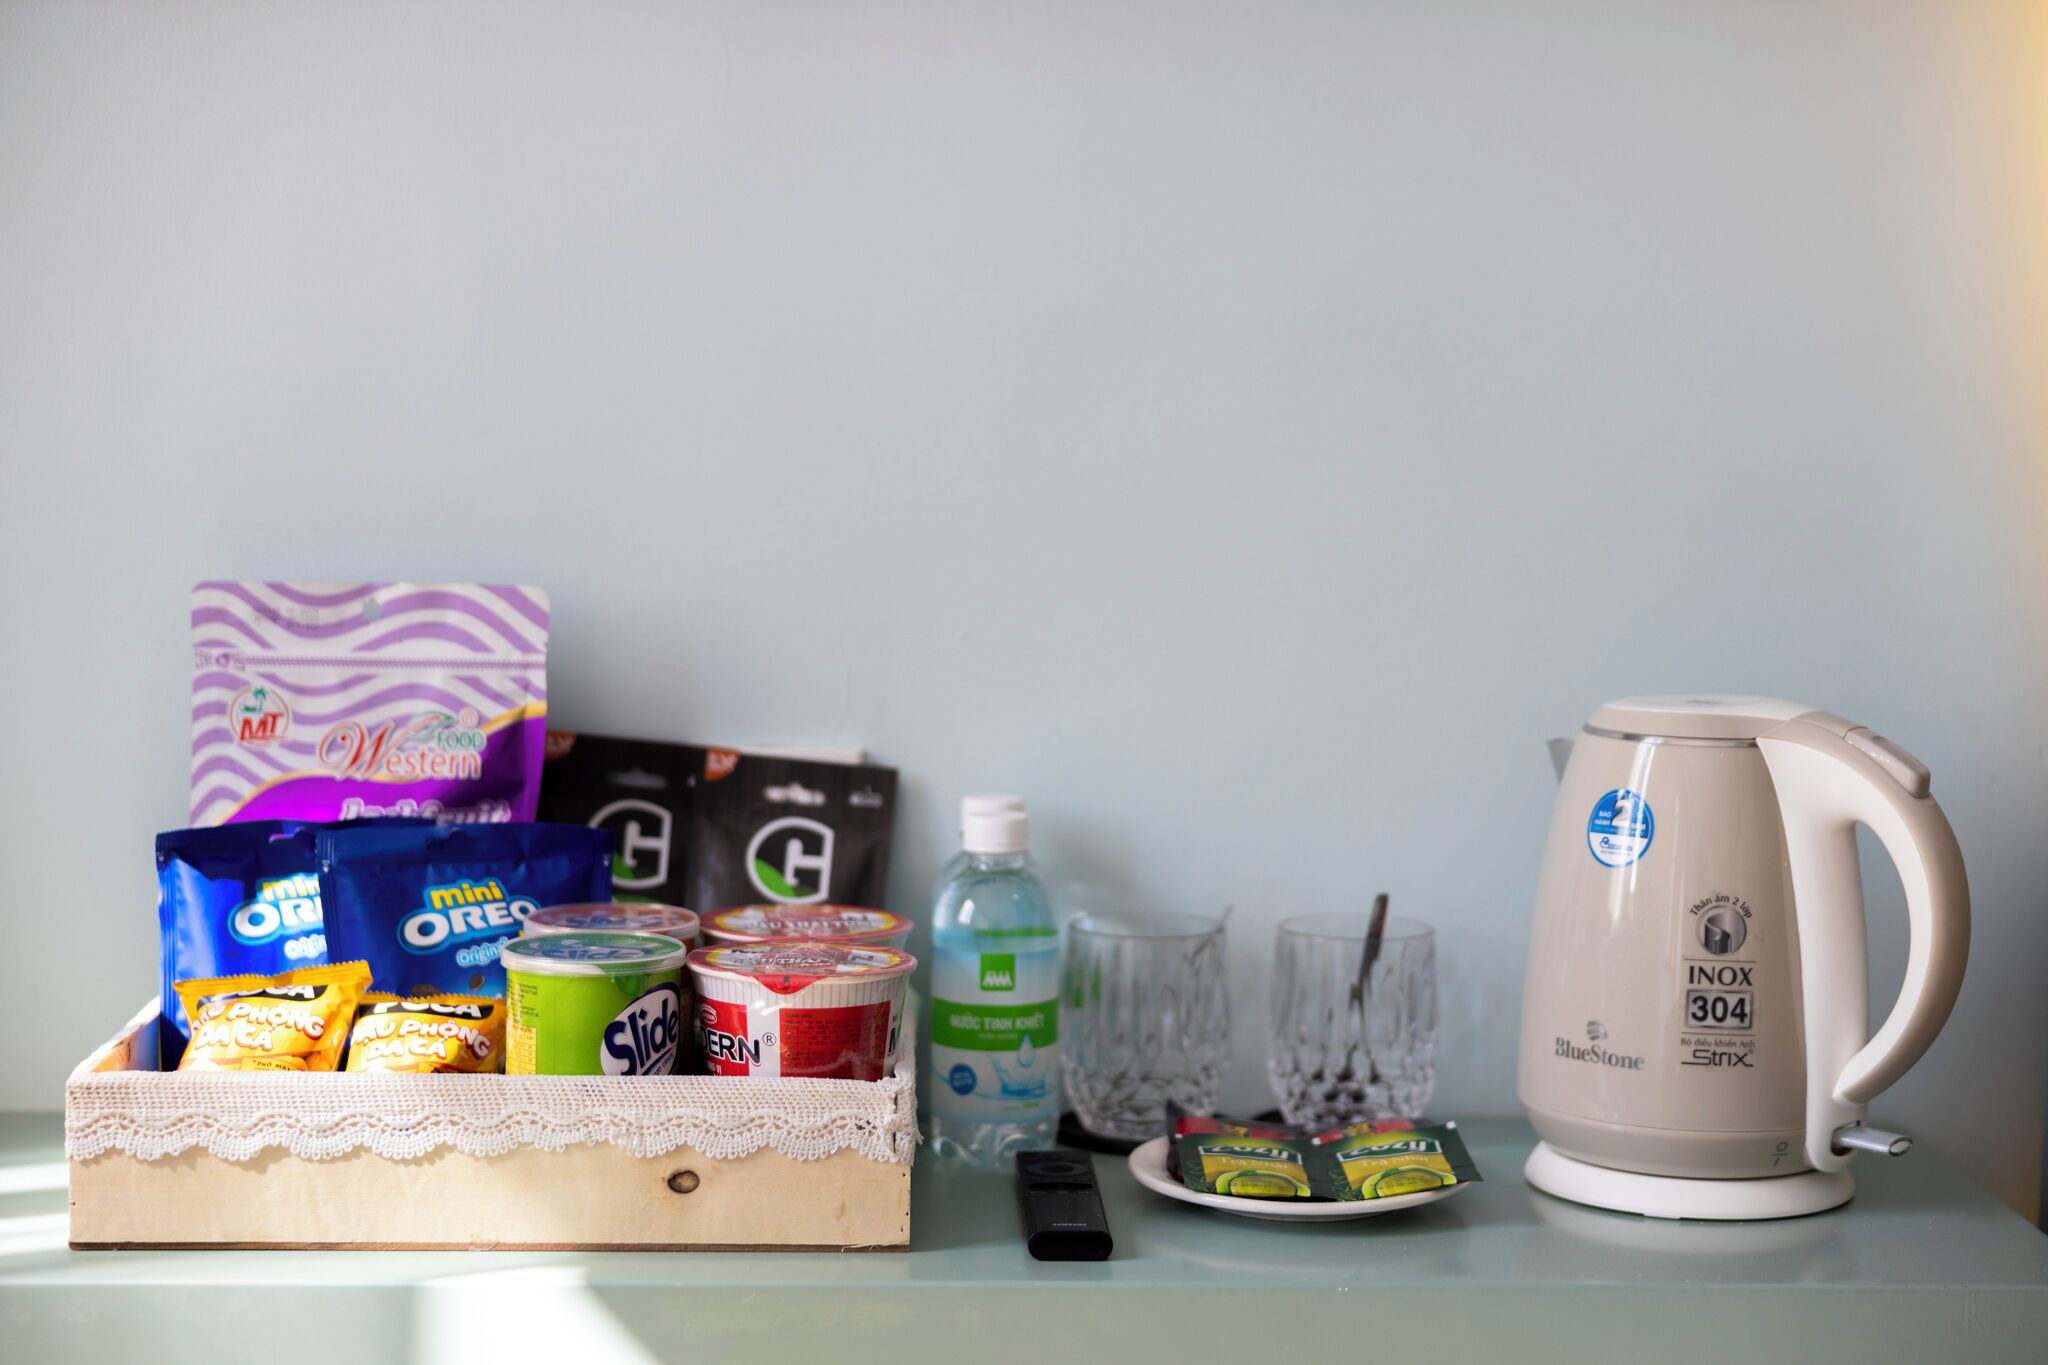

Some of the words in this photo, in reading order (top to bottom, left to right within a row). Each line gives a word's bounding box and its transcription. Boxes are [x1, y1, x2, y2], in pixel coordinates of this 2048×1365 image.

[318, 719, 482, 780] Western
[436, 730, 485, 750] FOOD
[262, 876, 320, 902] min
[430, 881, 504, 910] mini
[1732, 896, 1740, 906] 2
[235, 895, 323, 938] OR
[403, 900, 538, 947] OREO
[1688, 965, 1753, 987] INOX
[1690, 995, 1748, 1024] 304
[367, 1040, 404, 1060] DA
[604, 998, 678, 1076] Slide
[1555, 1036, 1645, 1071] BlueStone
[1681, 1049, 1755, 1067] Strix
